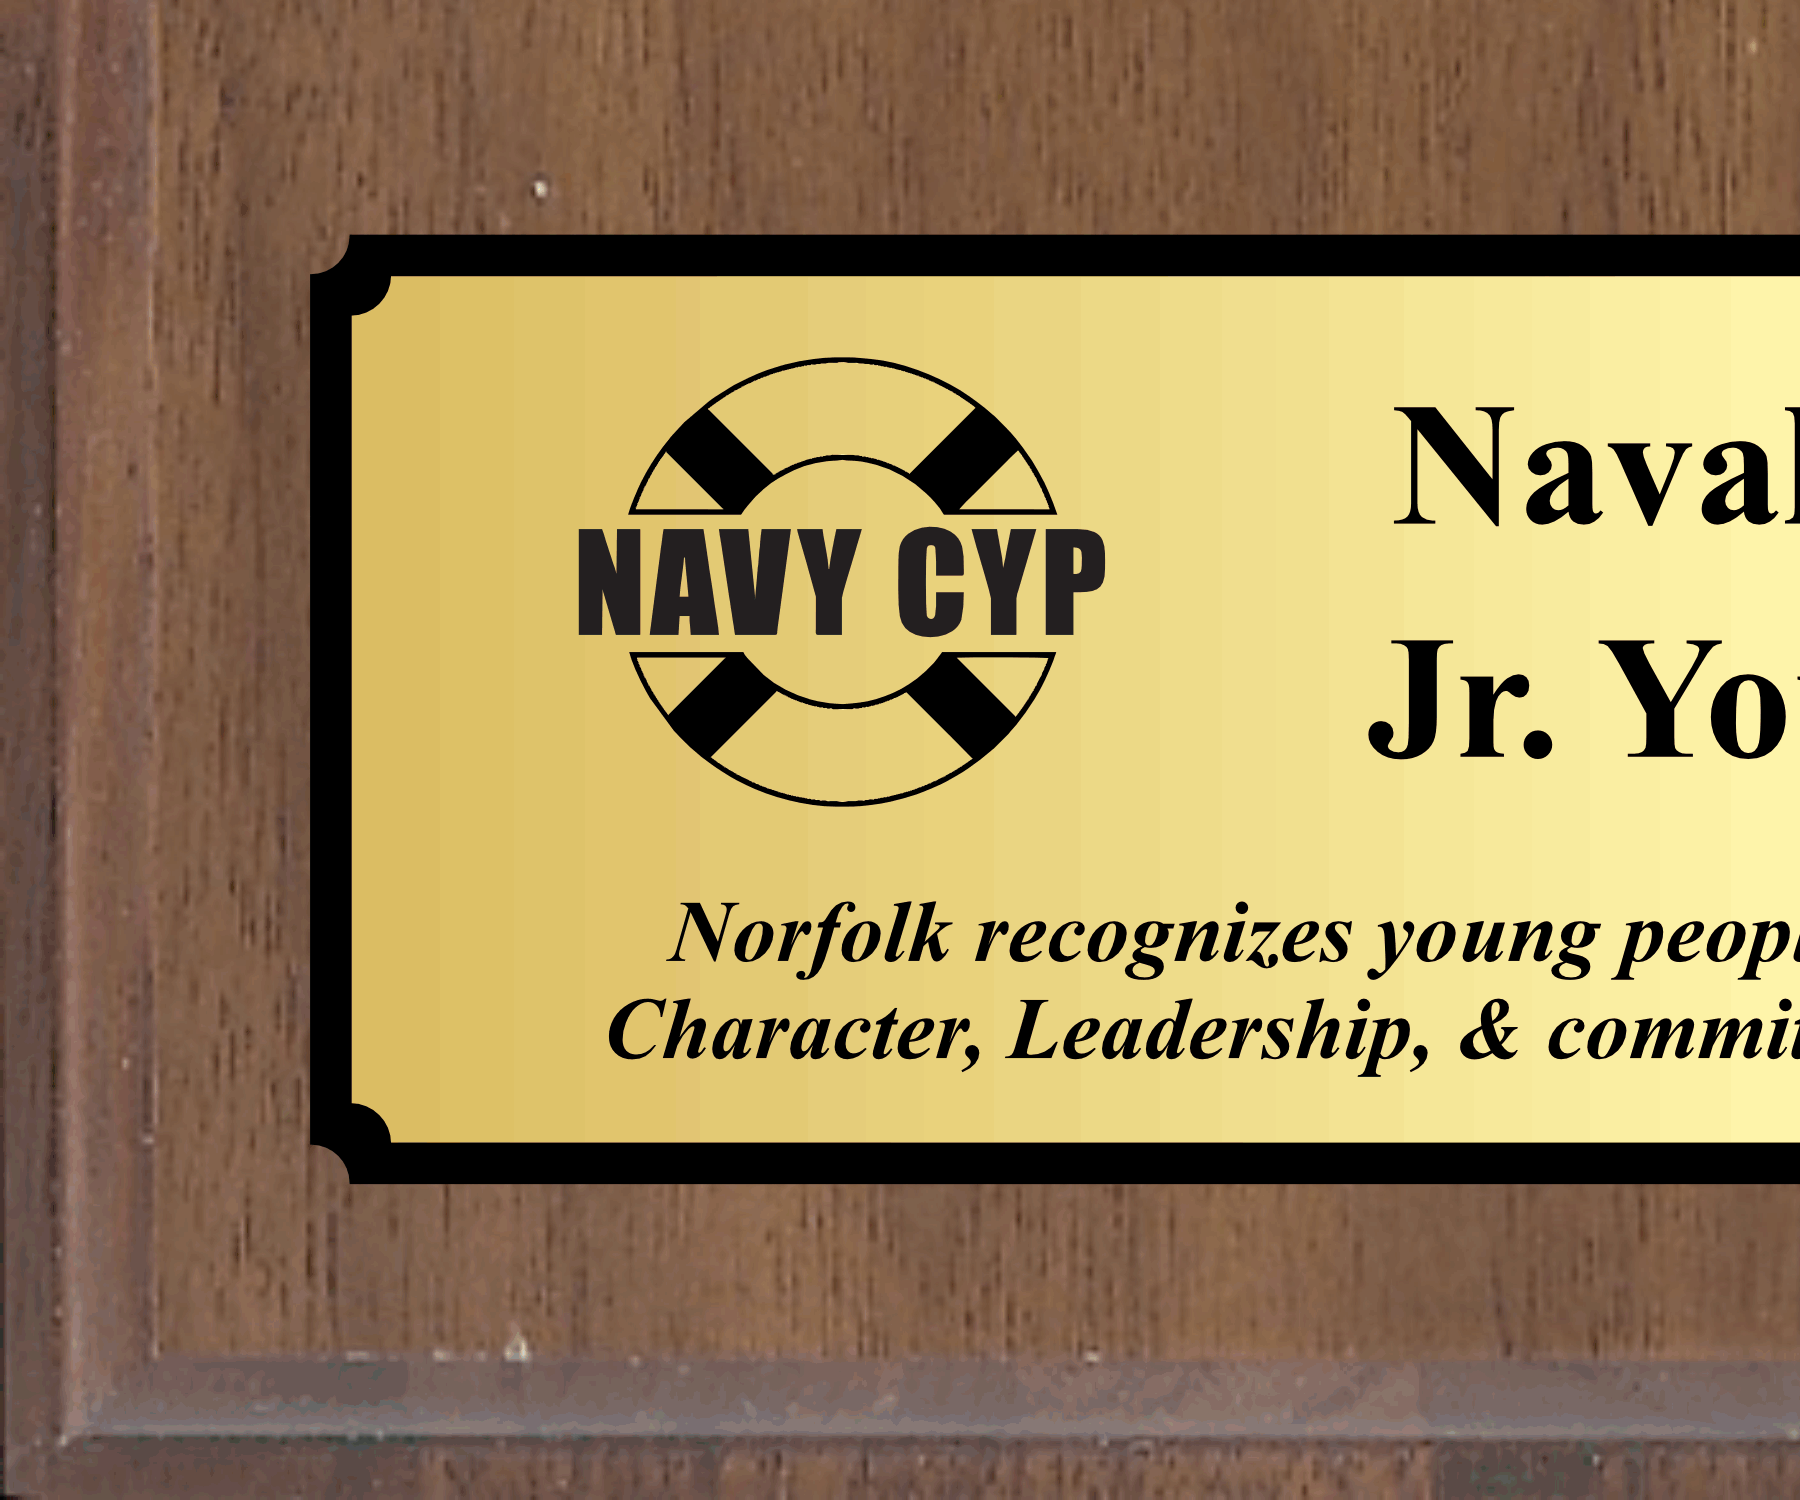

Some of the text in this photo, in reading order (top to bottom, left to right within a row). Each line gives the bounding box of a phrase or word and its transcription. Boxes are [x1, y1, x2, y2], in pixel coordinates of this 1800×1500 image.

[579, 527, 1106, 637] NAVY CYP
[1368, 640, 1552, 759] Jr.
[666, 901, 952, 980] Norfolk
[975, 902, 1352, 980] recognizes
[1367, 921, 1601, 980] young
[609, 999, 979, 1072] Character,
[1005, 999, 1428, 1077] Leadership,
[1460, 999, 1518, 1059] &
